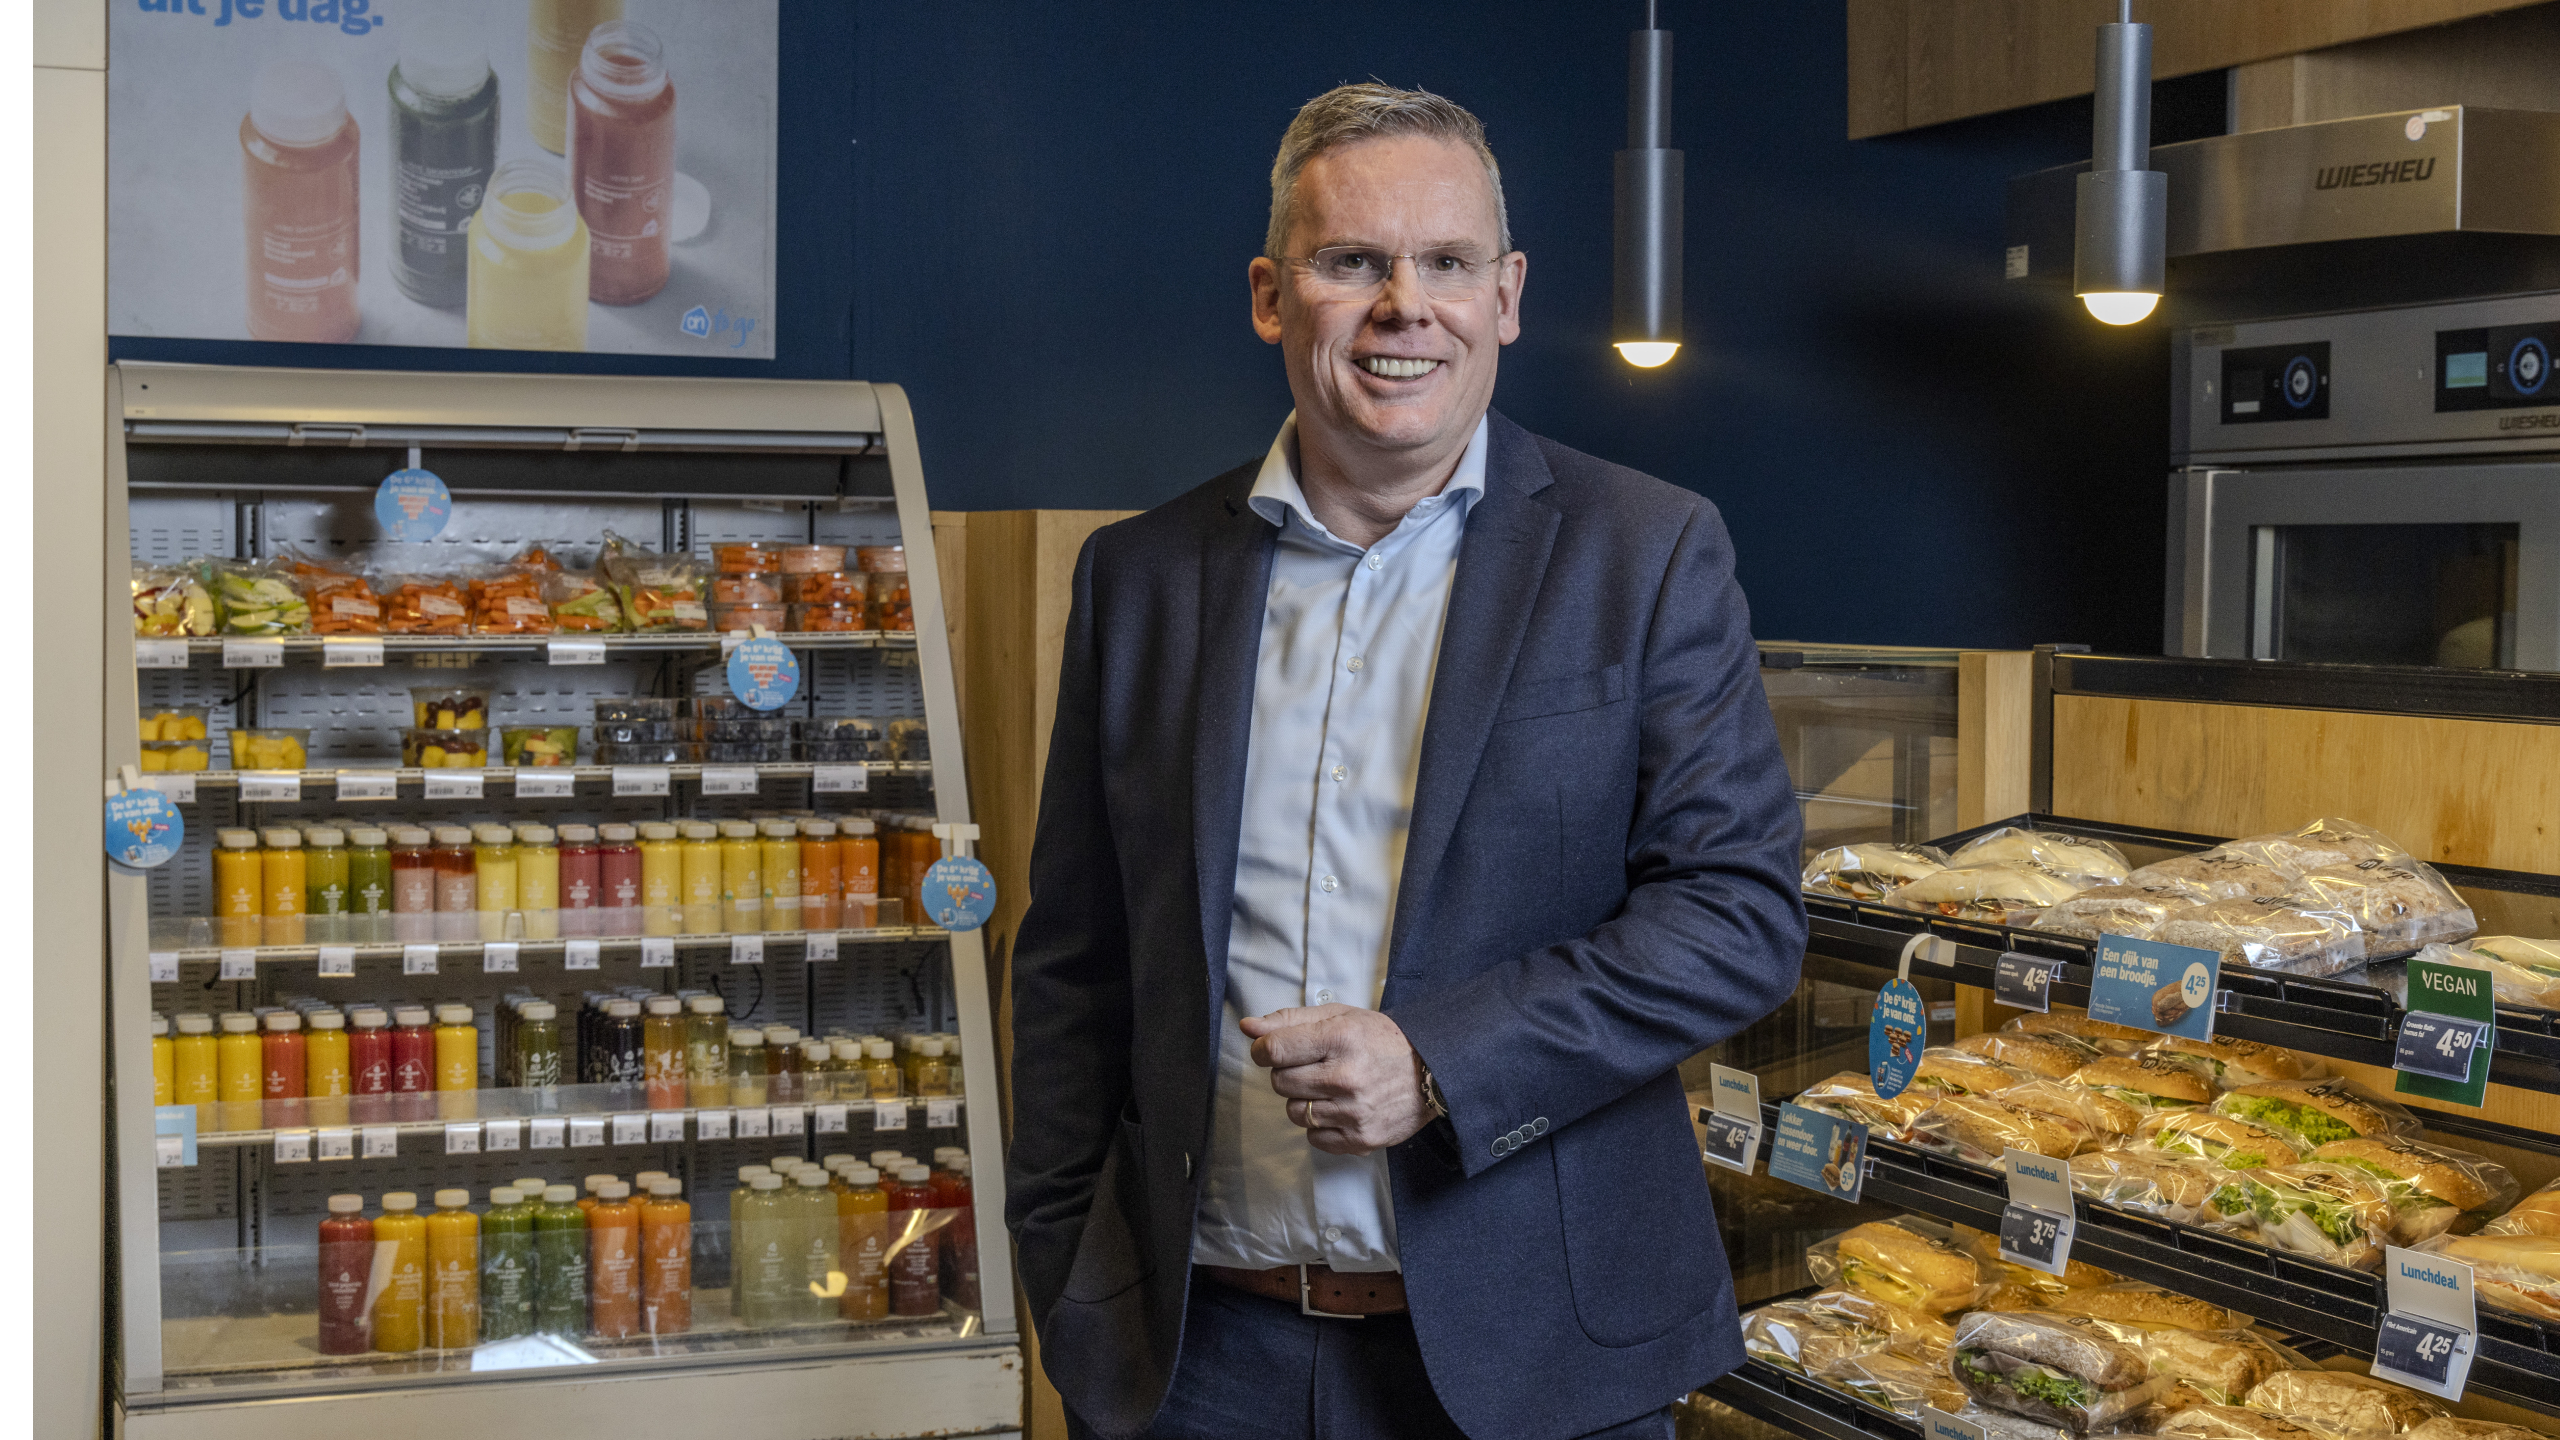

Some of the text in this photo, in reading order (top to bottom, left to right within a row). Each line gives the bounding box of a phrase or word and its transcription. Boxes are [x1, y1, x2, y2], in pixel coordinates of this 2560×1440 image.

[2315, 157, 2436, 191] WIESHEU
[2102, 947, 2159, 970] Een dijk van
[2022, 967, 2049, 992] 4.25
[2100, 966, 2158, 989] een broodje.
[2185, 974, 2206, 996] 4.25
[2422, 969, 2477, 997] VEGAN
[1883, 991, 1893, 1004] De
[1901, 995, 1917, 1014] krijg
[1882, 1004, 1916, 1025] je van ons.
[2436, 1028, 2472, 1058] 4.50
[1719, 1076, 1751, 1095] Lunchdeal.
[1781, 1110, 1804, 1127] Lekker
[1726, 1126, 1747, 1149] 4.25
[1779, 1123, 1815, 1144] tussendoor,
[1777, 1137, 1818, 1157] en weer door.
[2015, 1161, 2060, 1184] Lunchdeal.
[2029, 1218, 2057, 1246] 3.75
[2400, 1262, 2460, 1291] Lunchdeal.
[2415, 1332, 2453, 1363] 4.25
